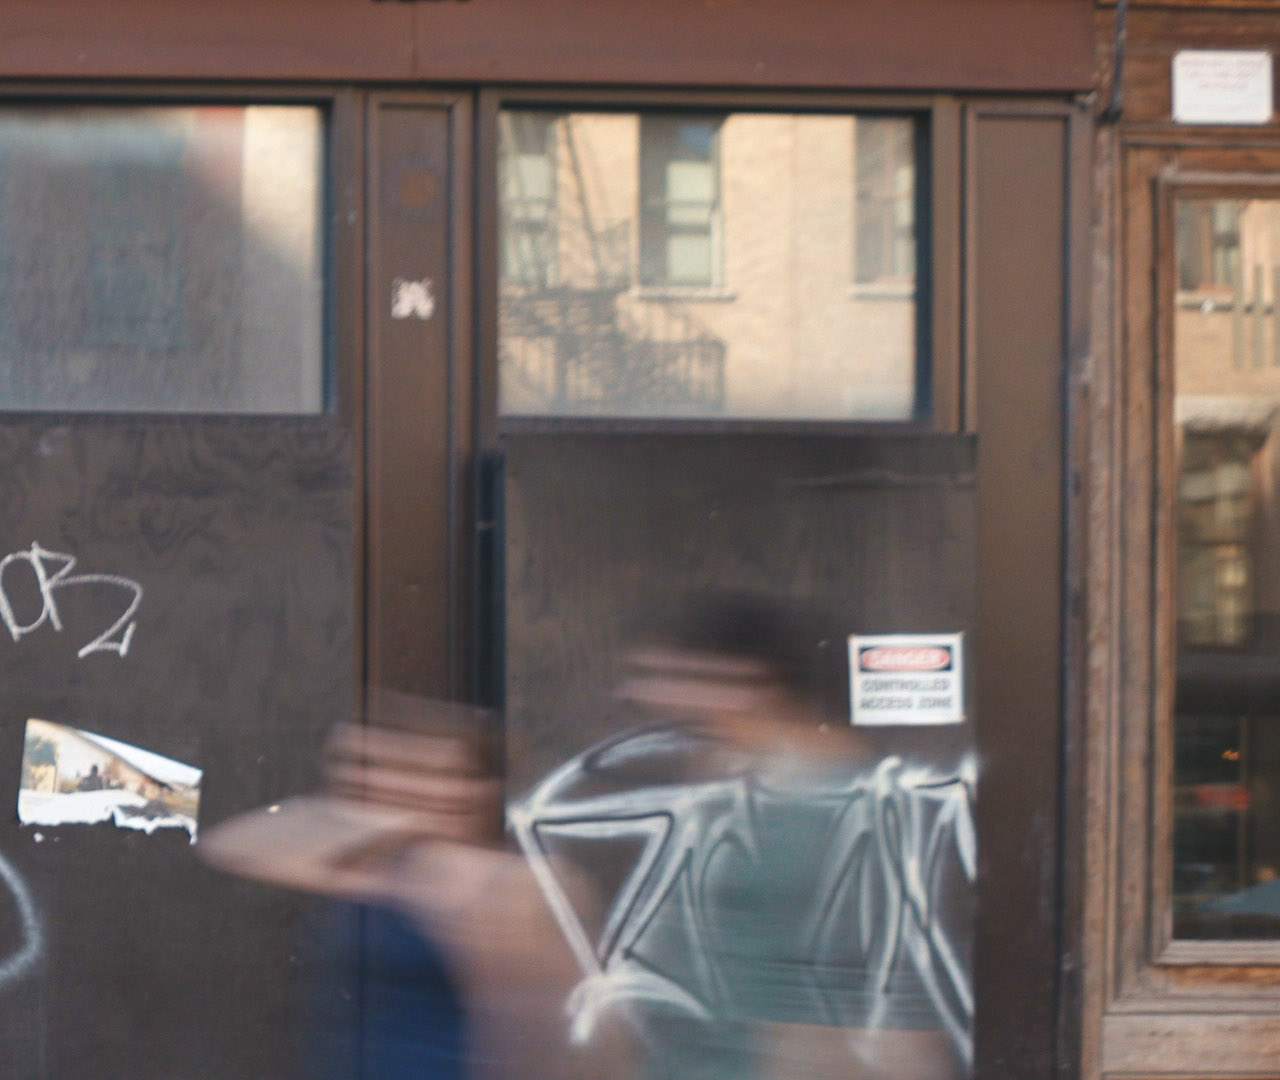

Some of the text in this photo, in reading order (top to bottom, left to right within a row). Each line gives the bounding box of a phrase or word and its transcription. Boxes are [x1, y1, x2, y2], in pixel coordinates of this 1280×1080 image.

[861, 678, 952, 692] CONTROLLED
[860, 696, 953, 710] ACCESS ZONE
